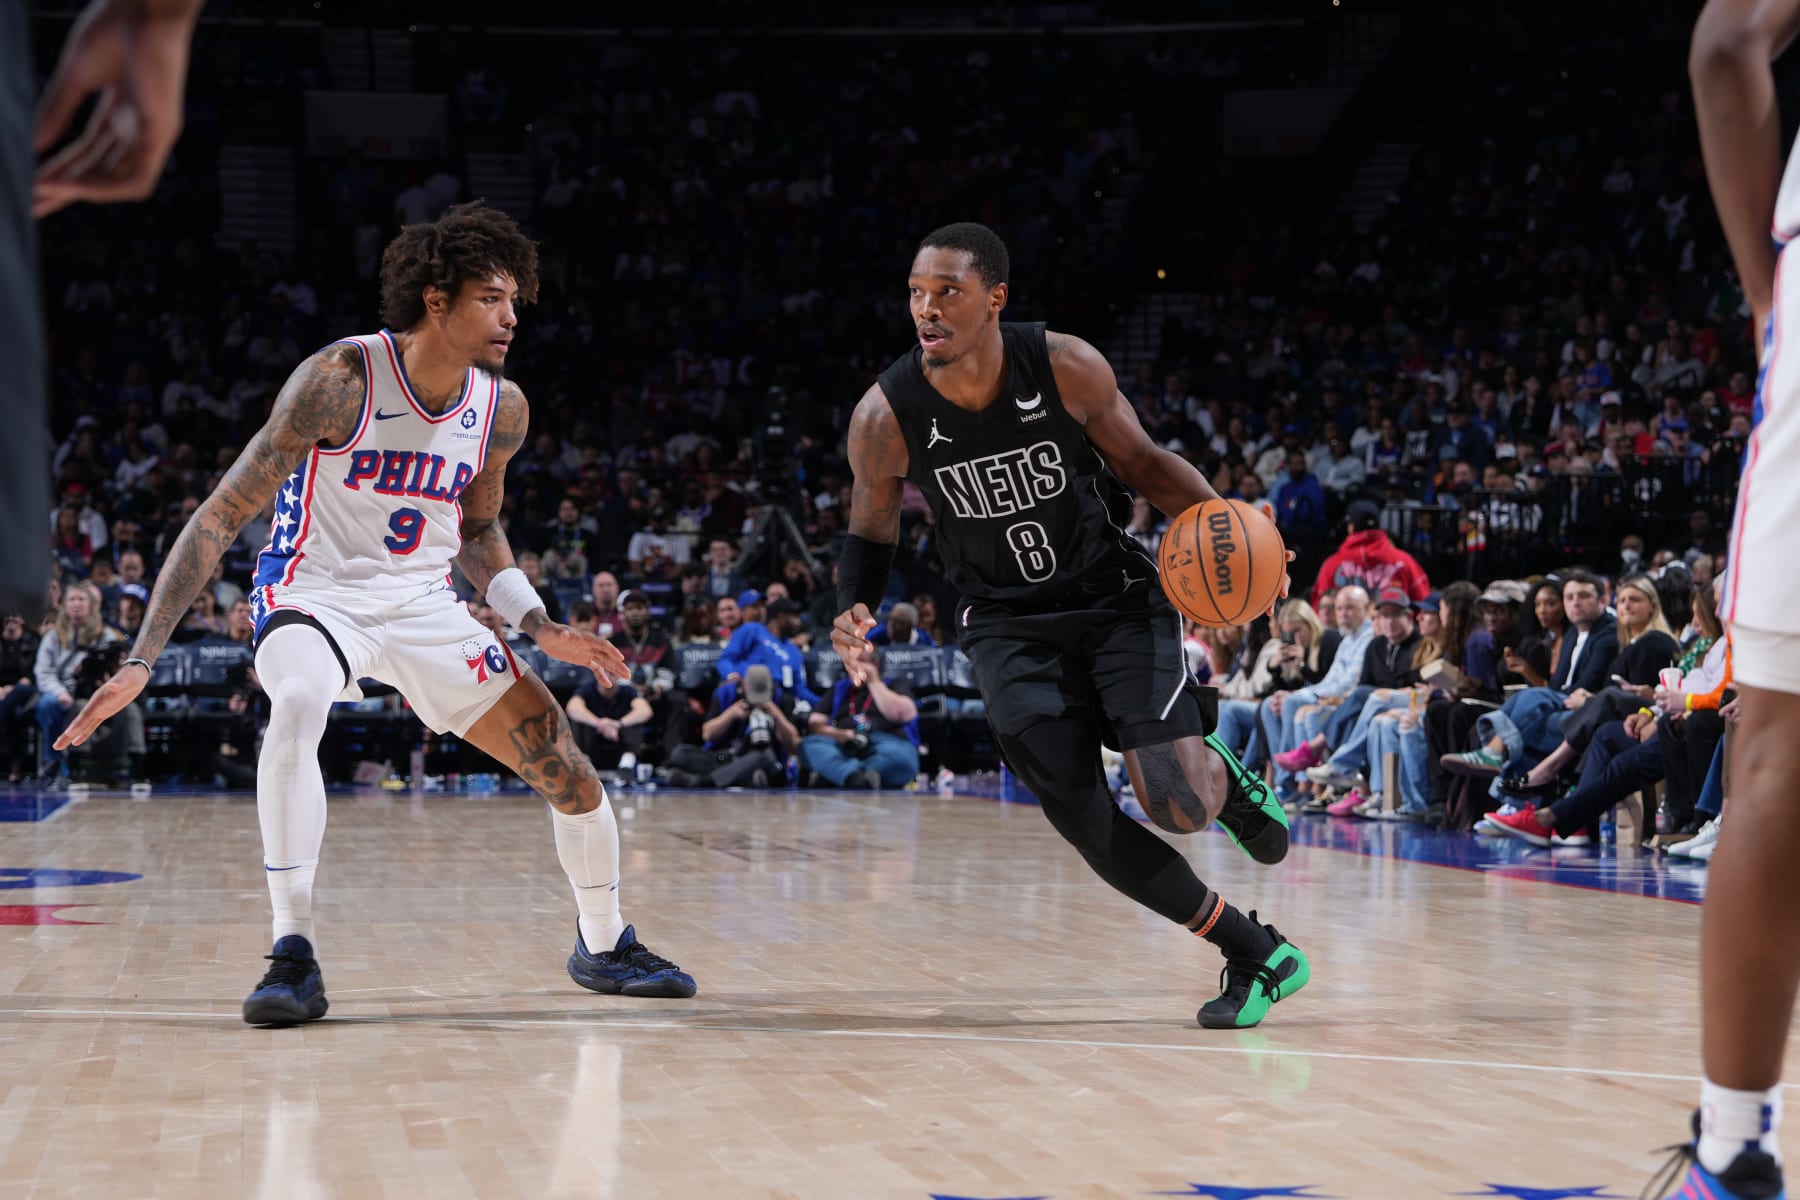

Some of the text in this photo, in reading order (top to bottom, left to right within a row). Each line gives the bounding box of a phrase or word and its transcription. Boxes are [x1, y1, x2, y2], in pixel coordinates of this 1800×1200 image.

[450, 432, 482, 441] crypto.com
[1020, 409, 1047, 423] Webull
[934, 440, 1067, 518] NETS
[383, 507, 427, 555] 9
[1006, 521, 1057, 583] 8
[1206, 510, 1237, 597] Wilson
